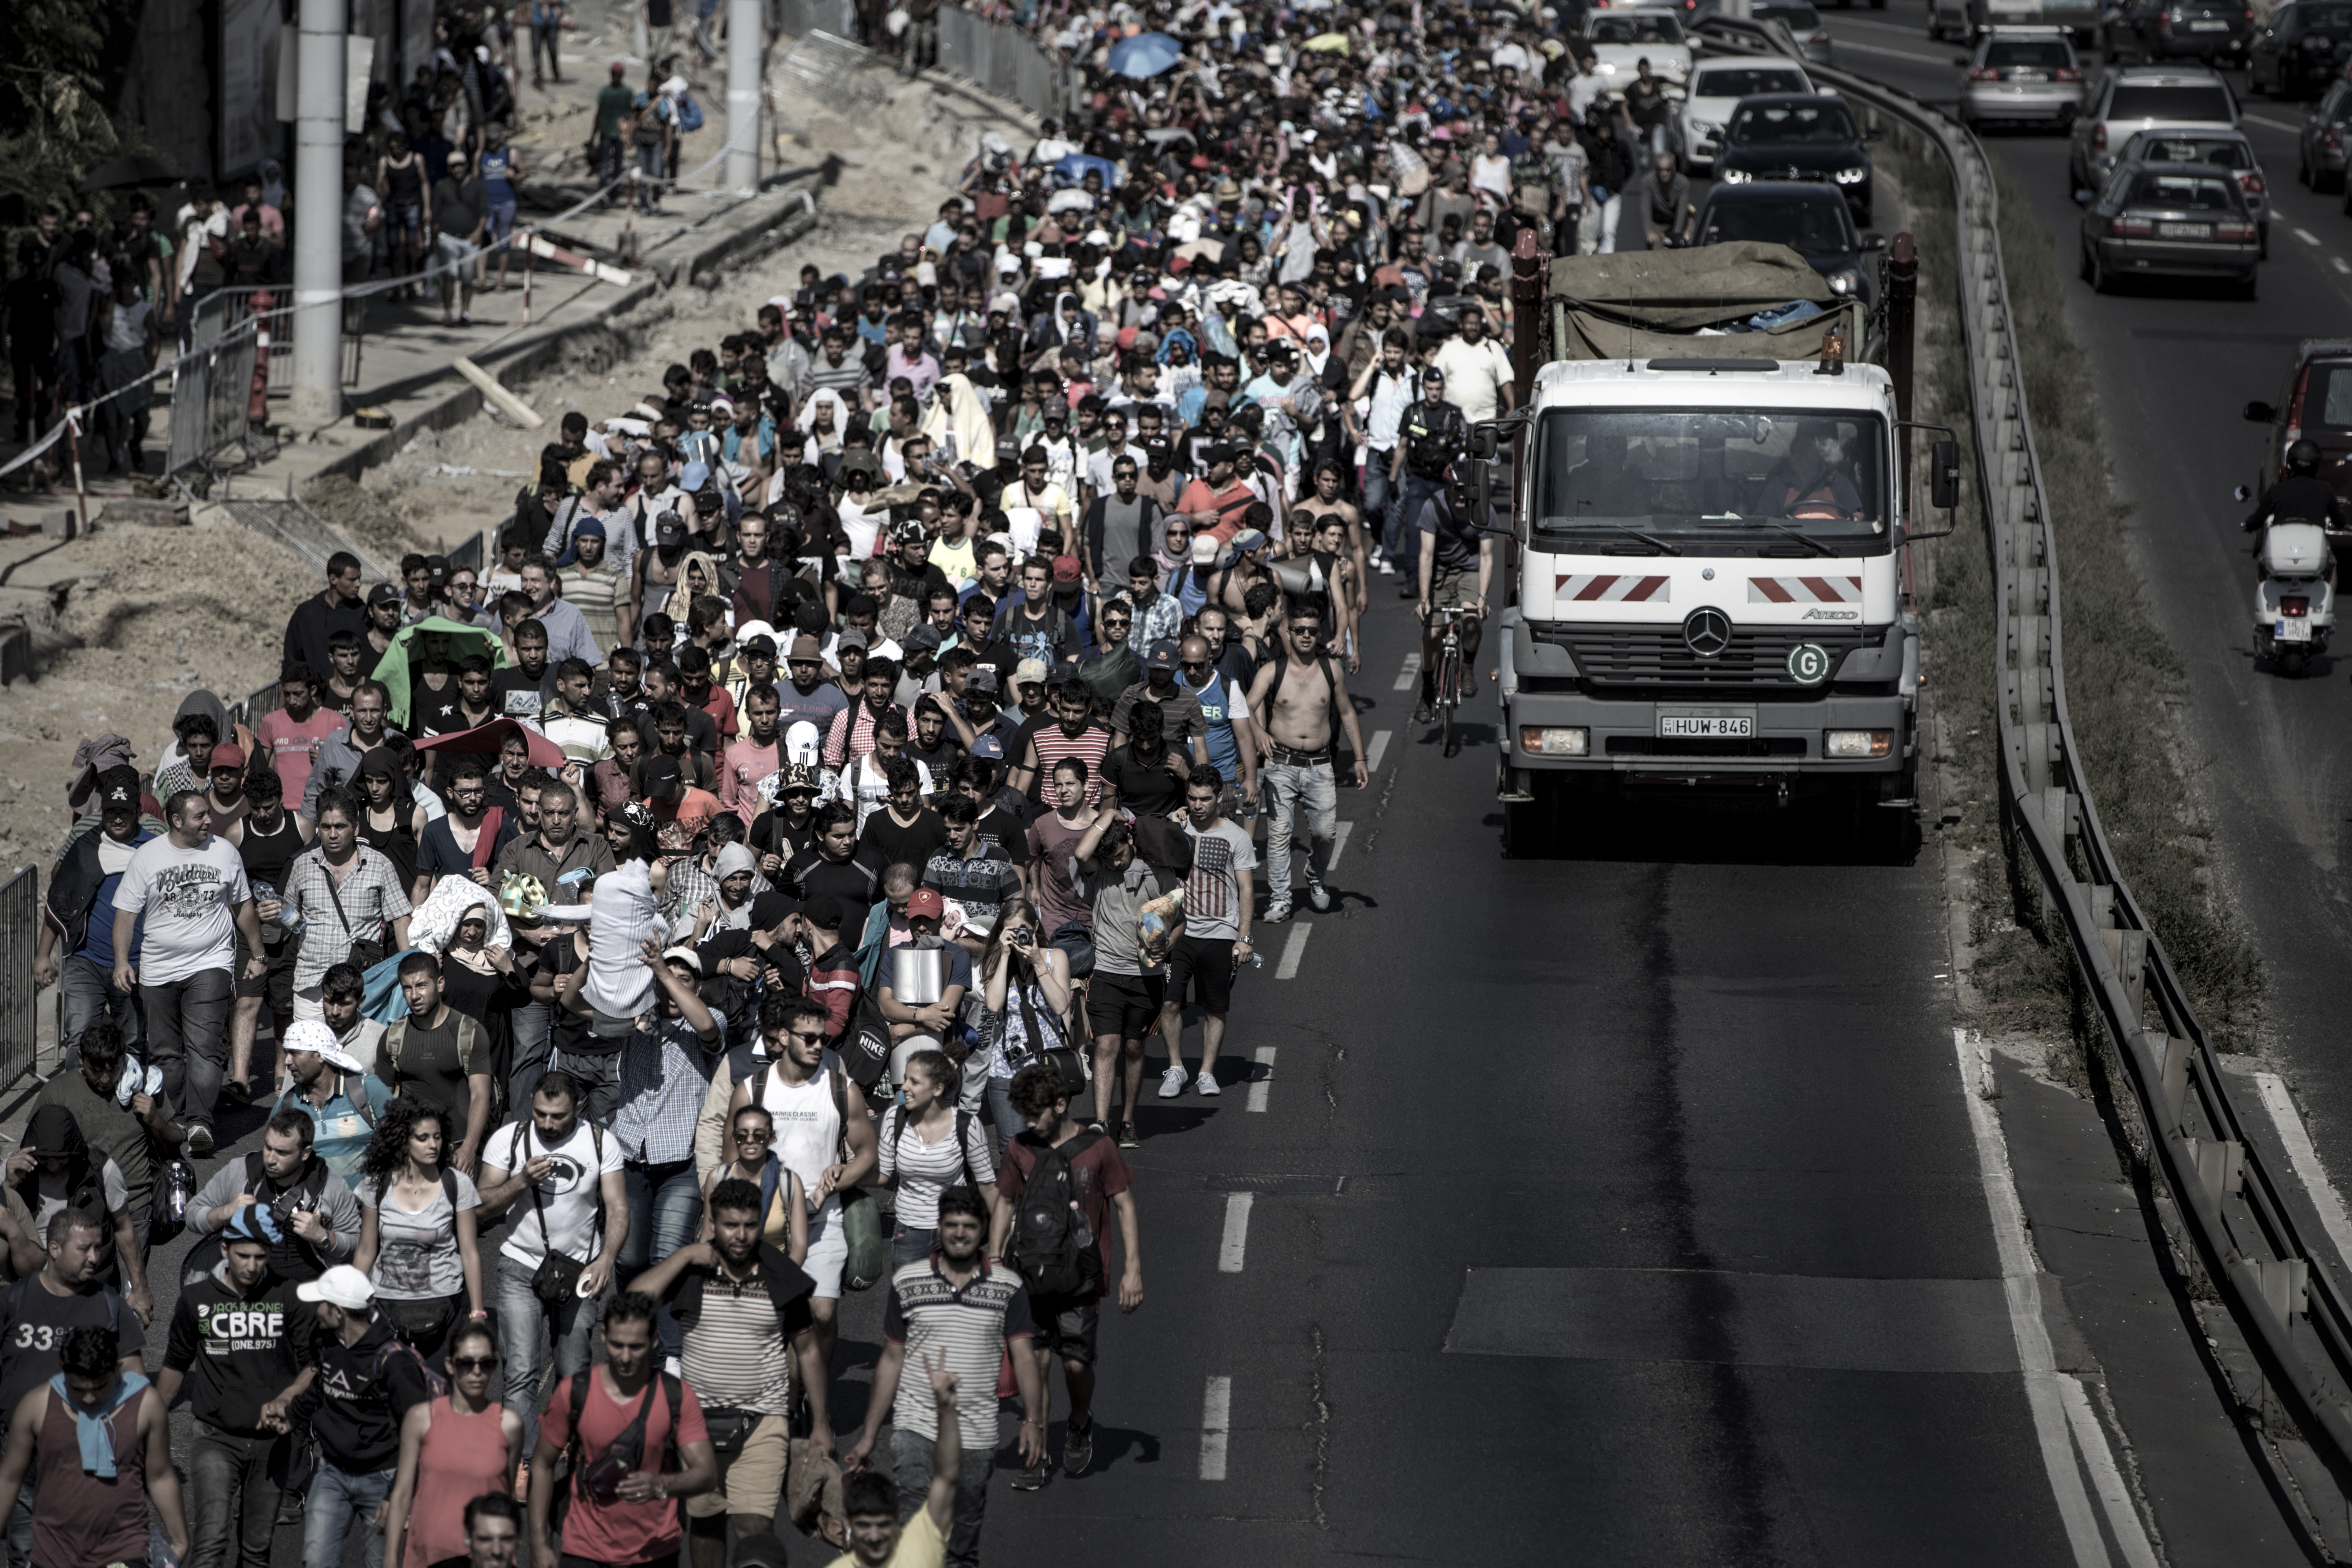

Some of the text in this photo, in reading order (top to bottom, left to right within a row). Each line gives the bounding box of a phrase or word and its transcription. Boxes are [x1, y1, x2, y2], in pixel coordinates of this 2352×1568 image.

[1802, 608, 1858, 620] ATEGO
[1801, 652, 1818, 675] G
[1201, 705, 1223, 717] ER
[1676, 720, 1748, 733] HUW-846
[164, 890, 214, 902] 18 73
[174, 910, 203, 919] Hungary
[860, 1035, 885, 1057] NIKE
[211, 1302, 238, 1313] JACK
[211, 1312, 284, 1338] CBRE
[15, 1323, 53, 1351] 33
